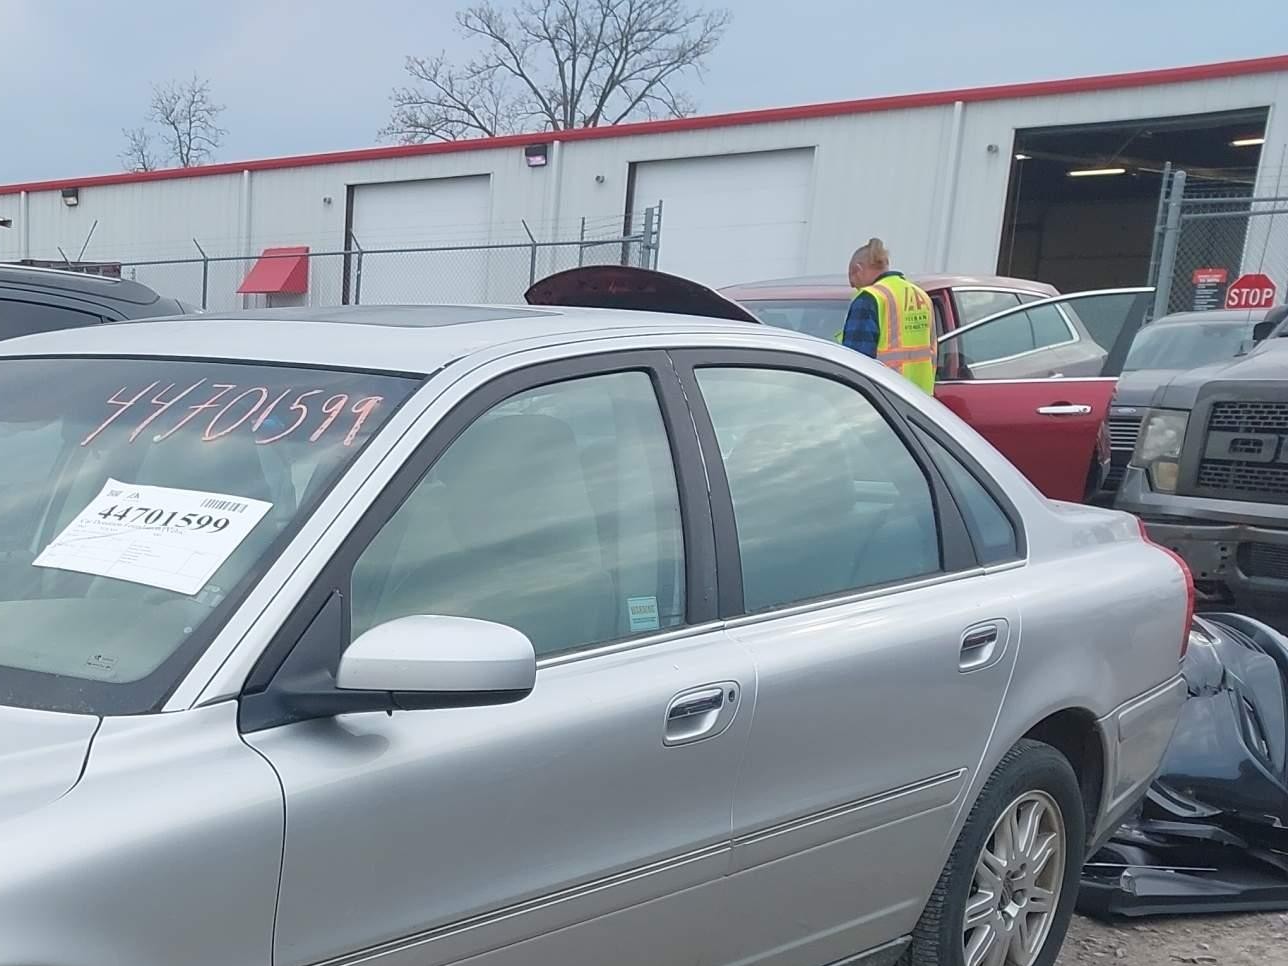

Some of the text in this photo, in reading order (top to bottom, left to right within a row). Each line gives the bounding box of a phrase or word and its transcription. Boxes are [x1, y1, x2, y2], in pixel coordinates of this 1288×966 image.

[1228, 288, 1273, 306] STOP
[81, 378, 384, 446] 44701599
[98, 504, 230, 534] 44701599
